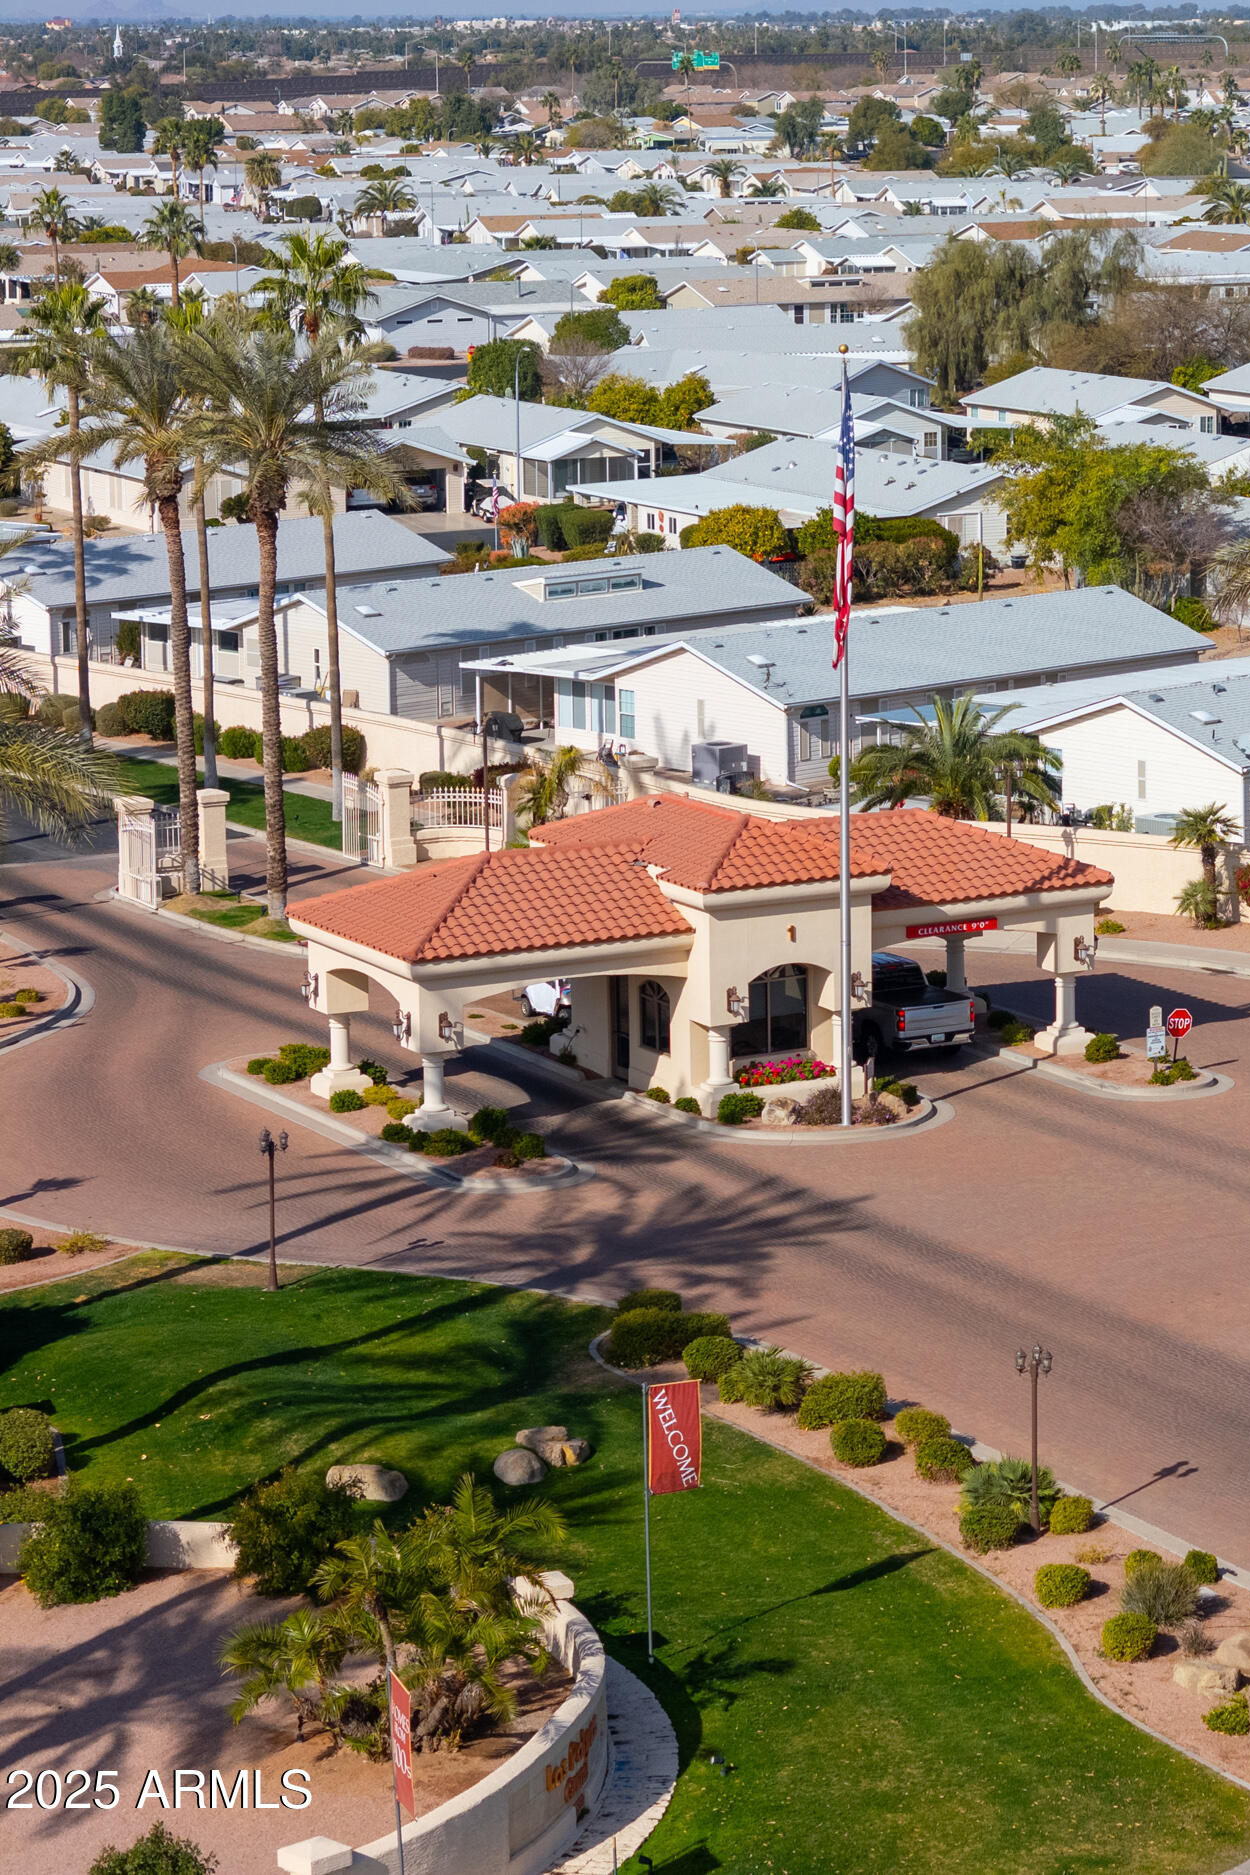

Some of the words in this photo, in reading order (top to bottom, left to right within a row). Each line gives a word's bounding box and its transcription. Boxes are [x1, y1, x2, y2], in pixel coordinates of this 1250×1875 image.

[918, 924, 967, 935] CLEARANCE
[1169, 1018, 1190, 1029] STOP
[652, 1388, 698, 1487] WELCOME
[545, 1757, 567, 1792] Las
